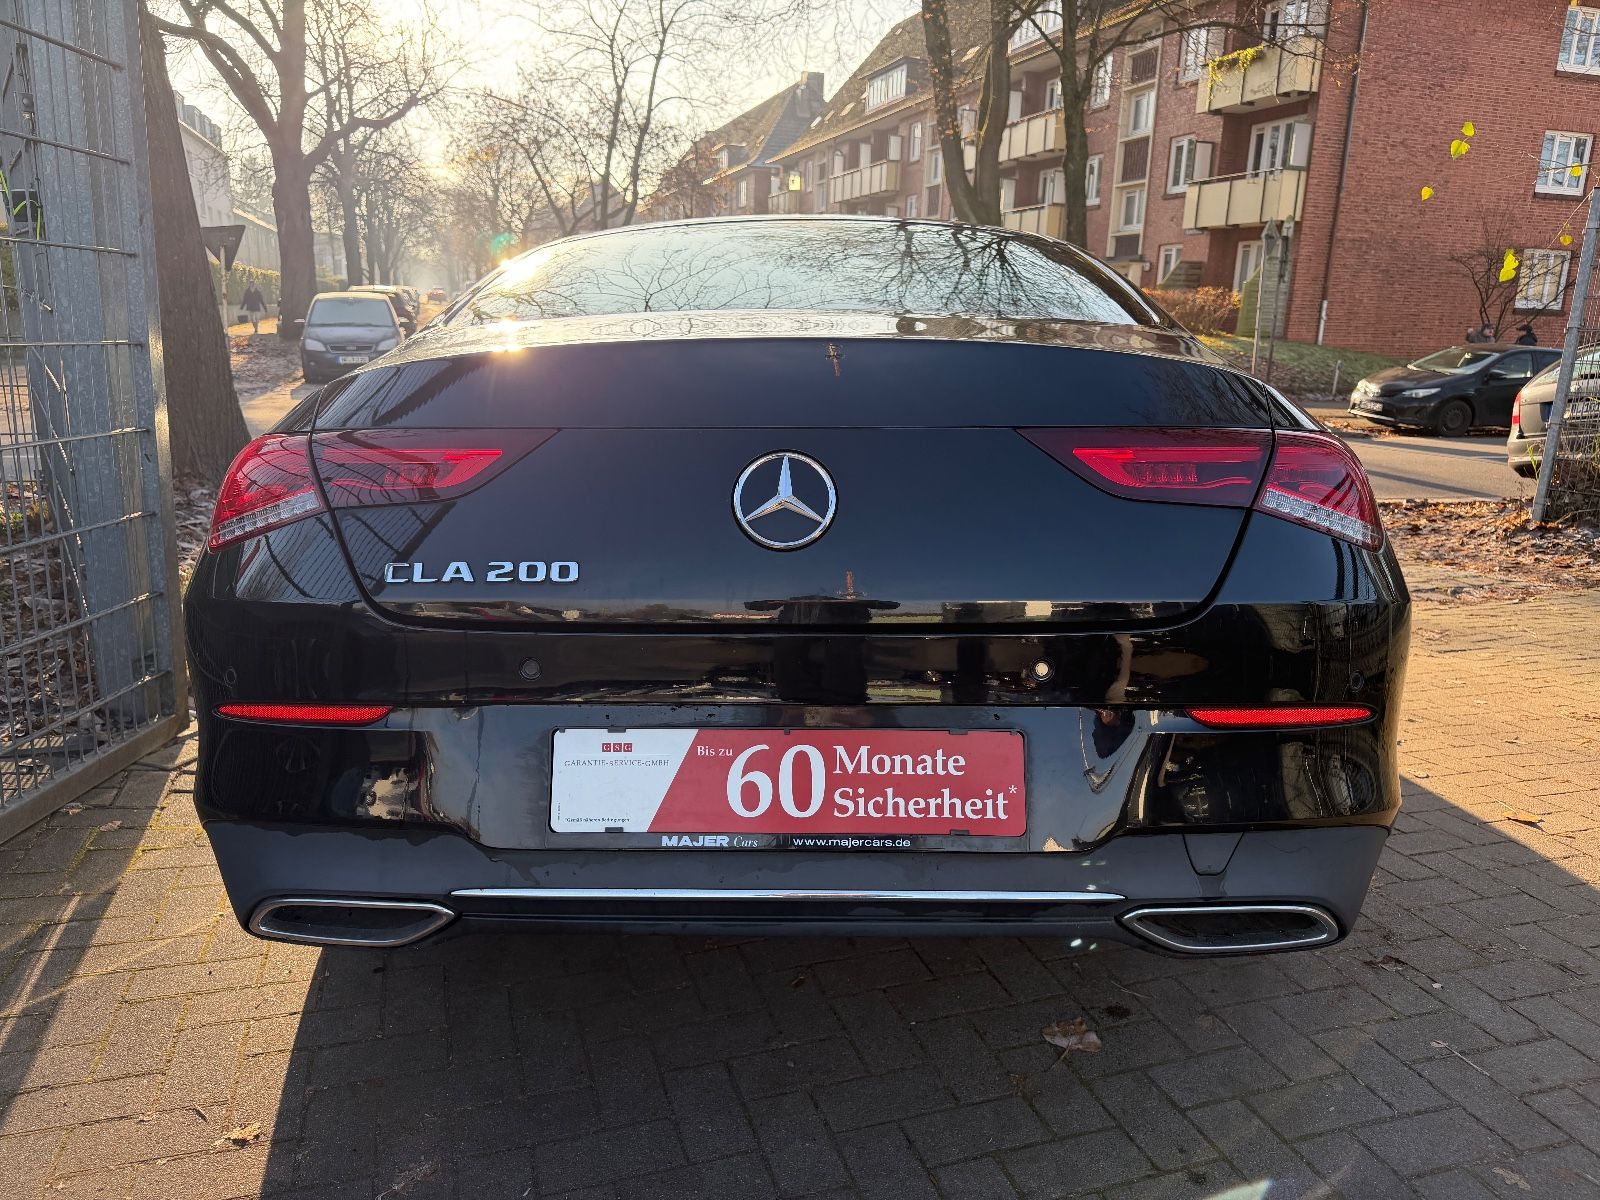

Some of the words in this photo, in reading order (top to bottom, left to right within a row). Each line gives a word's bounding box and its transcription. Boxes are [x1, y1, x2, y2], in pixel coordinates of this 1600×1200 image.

[384, 561, 474, 583] CLA
[486, 561, 579, 582] 200
[602, 743, 632, 752] GSG
[697, 745, 715, 756] Bis
[719, 748, 733, 756] zu
[833, 745, 966, 776] Monate
[727, 744, 826, 818] 60
[661, 836, 730, 847] MAJER
[733, 836, 759, 848] Cars
[793, 838, 911, 848] www.majercars.de
